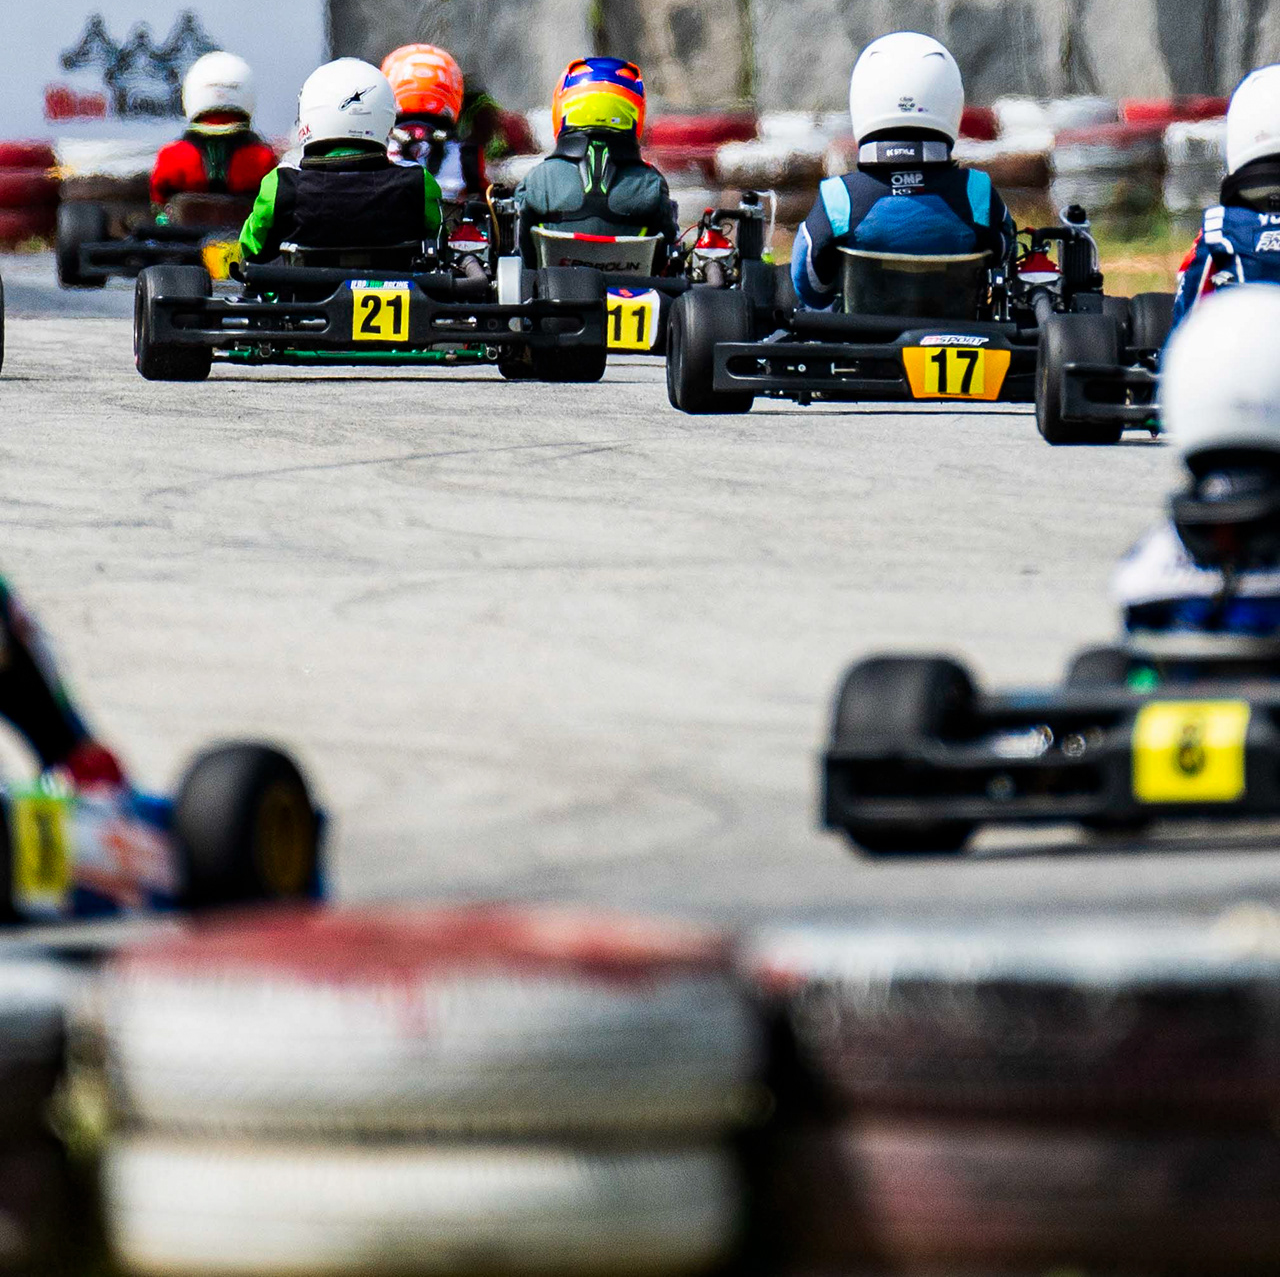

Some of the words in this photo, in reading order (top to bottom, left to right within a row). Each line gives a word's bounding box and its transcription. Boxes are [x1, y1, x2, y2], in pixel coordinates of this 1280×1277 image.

[891, 173, 924, 185] OMP
[360, 295, 403, 335] 21
[608, 305, 647, 342] 11
[931, 348, 979, 394] 17
